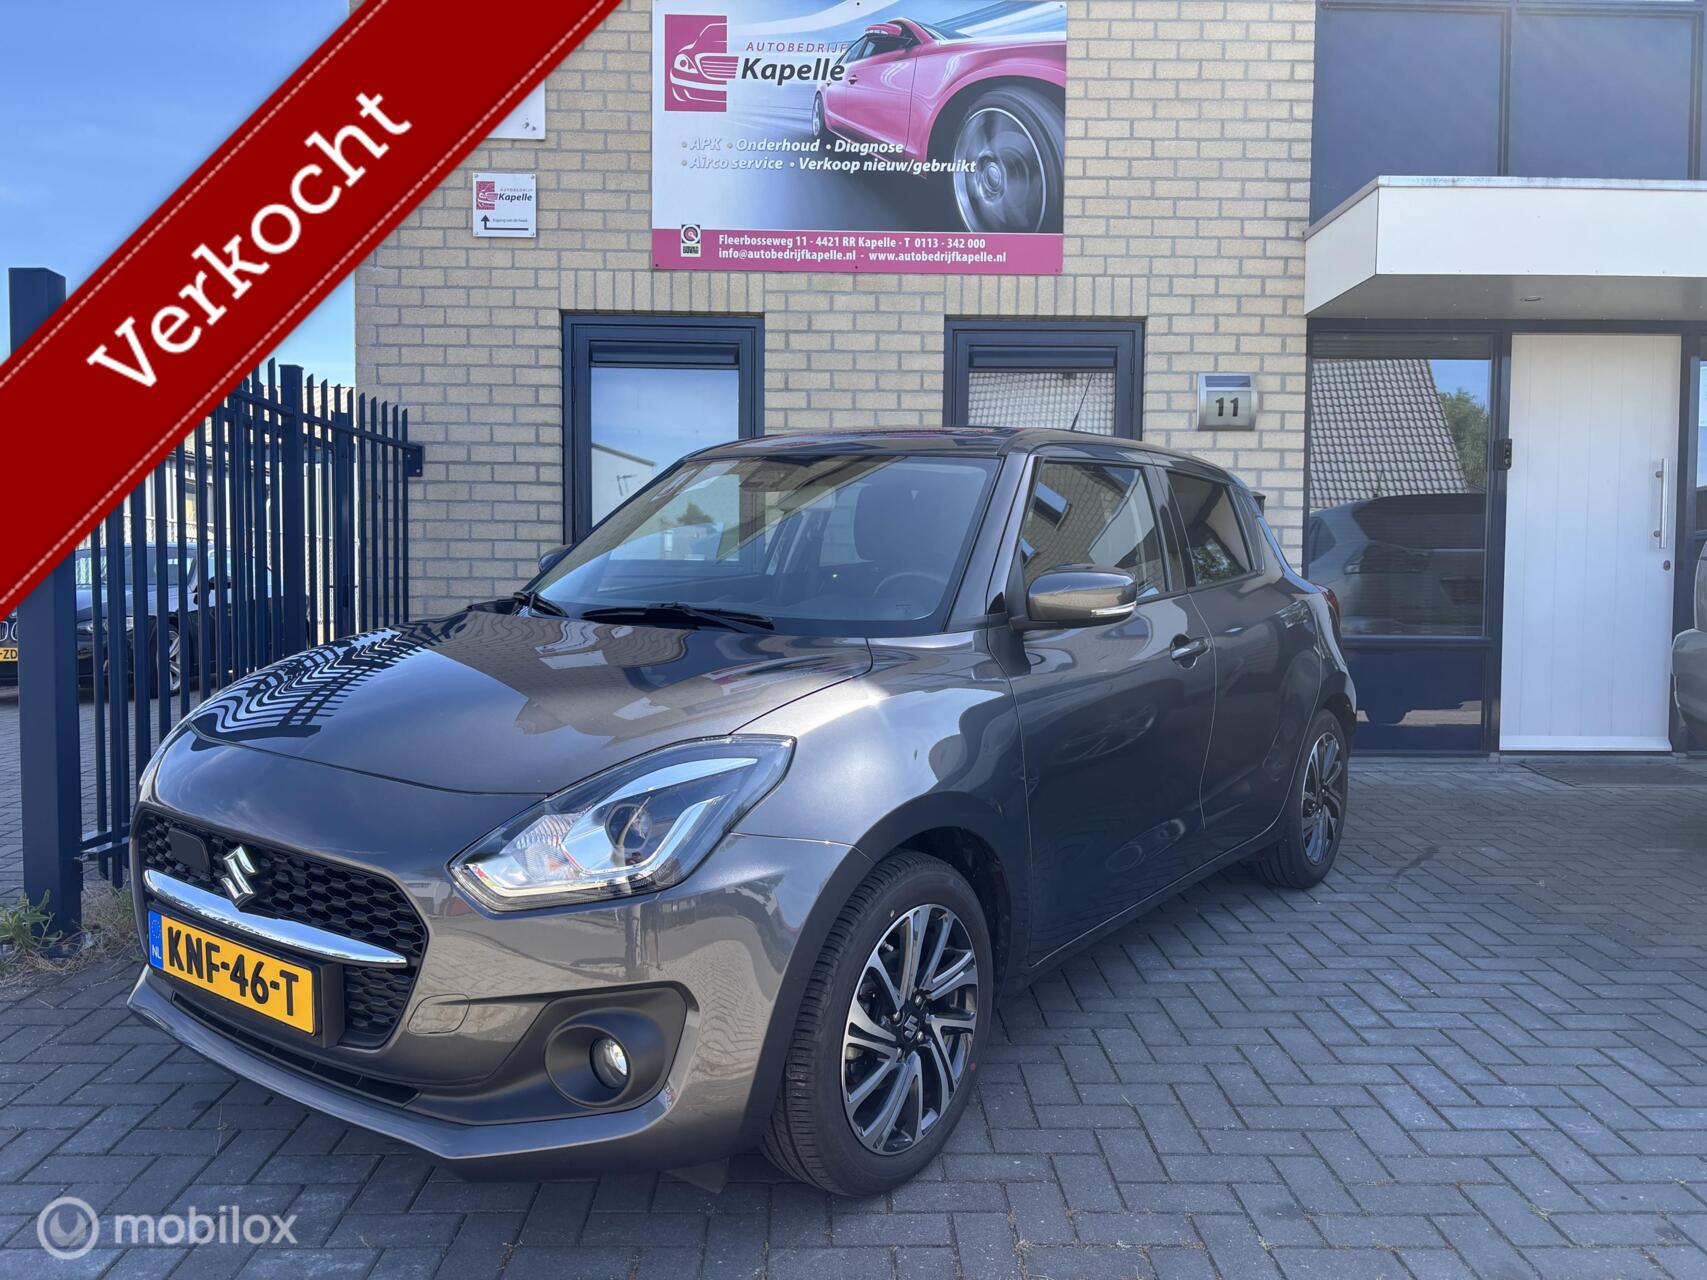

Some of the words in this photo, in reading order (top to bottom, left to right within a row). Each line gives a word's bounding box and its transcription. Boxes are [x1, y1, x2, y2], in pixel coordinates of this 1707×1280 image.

[745, 41, 848, 53] AUTOBEDRIJF
[741, 57, 845, 86] Kapelle
[689, 138, 722, 151] APK
[736, 138, 821, 152] Onderhoud
[834, 139, 904, 156] Diagnose
[731, 157, 783, 170] service
[799, 157, 861, 174] Verkoop
[863, 159, 977, 175] nieuw/gebruikt
[498, 192, 533, 203] Kapelle
[719, 234, 793, 248] Fleerbosseweg
[796, 236, 807, 247] 11
[815, 236, 840, 247] 4421
[842, 237, 856, 247] RR
[858, 237, 897, 250] Kapelle
[904, 237, 911, 248] T
[914, 238, 939, 248] 0113
[947, 238, 965, 249] 342
[967, 238, 986, 249] 000
[718, 247, 856, 262] info@autobedrijfkapelle.nl
[868, 251, 1007, 264] www.autobedrijfkapelle.nl
[1215, 396, 1239, 417] 11
[151, 944, 163, 960] NL
[167, 926, 300, 1017] KNF-46-T
